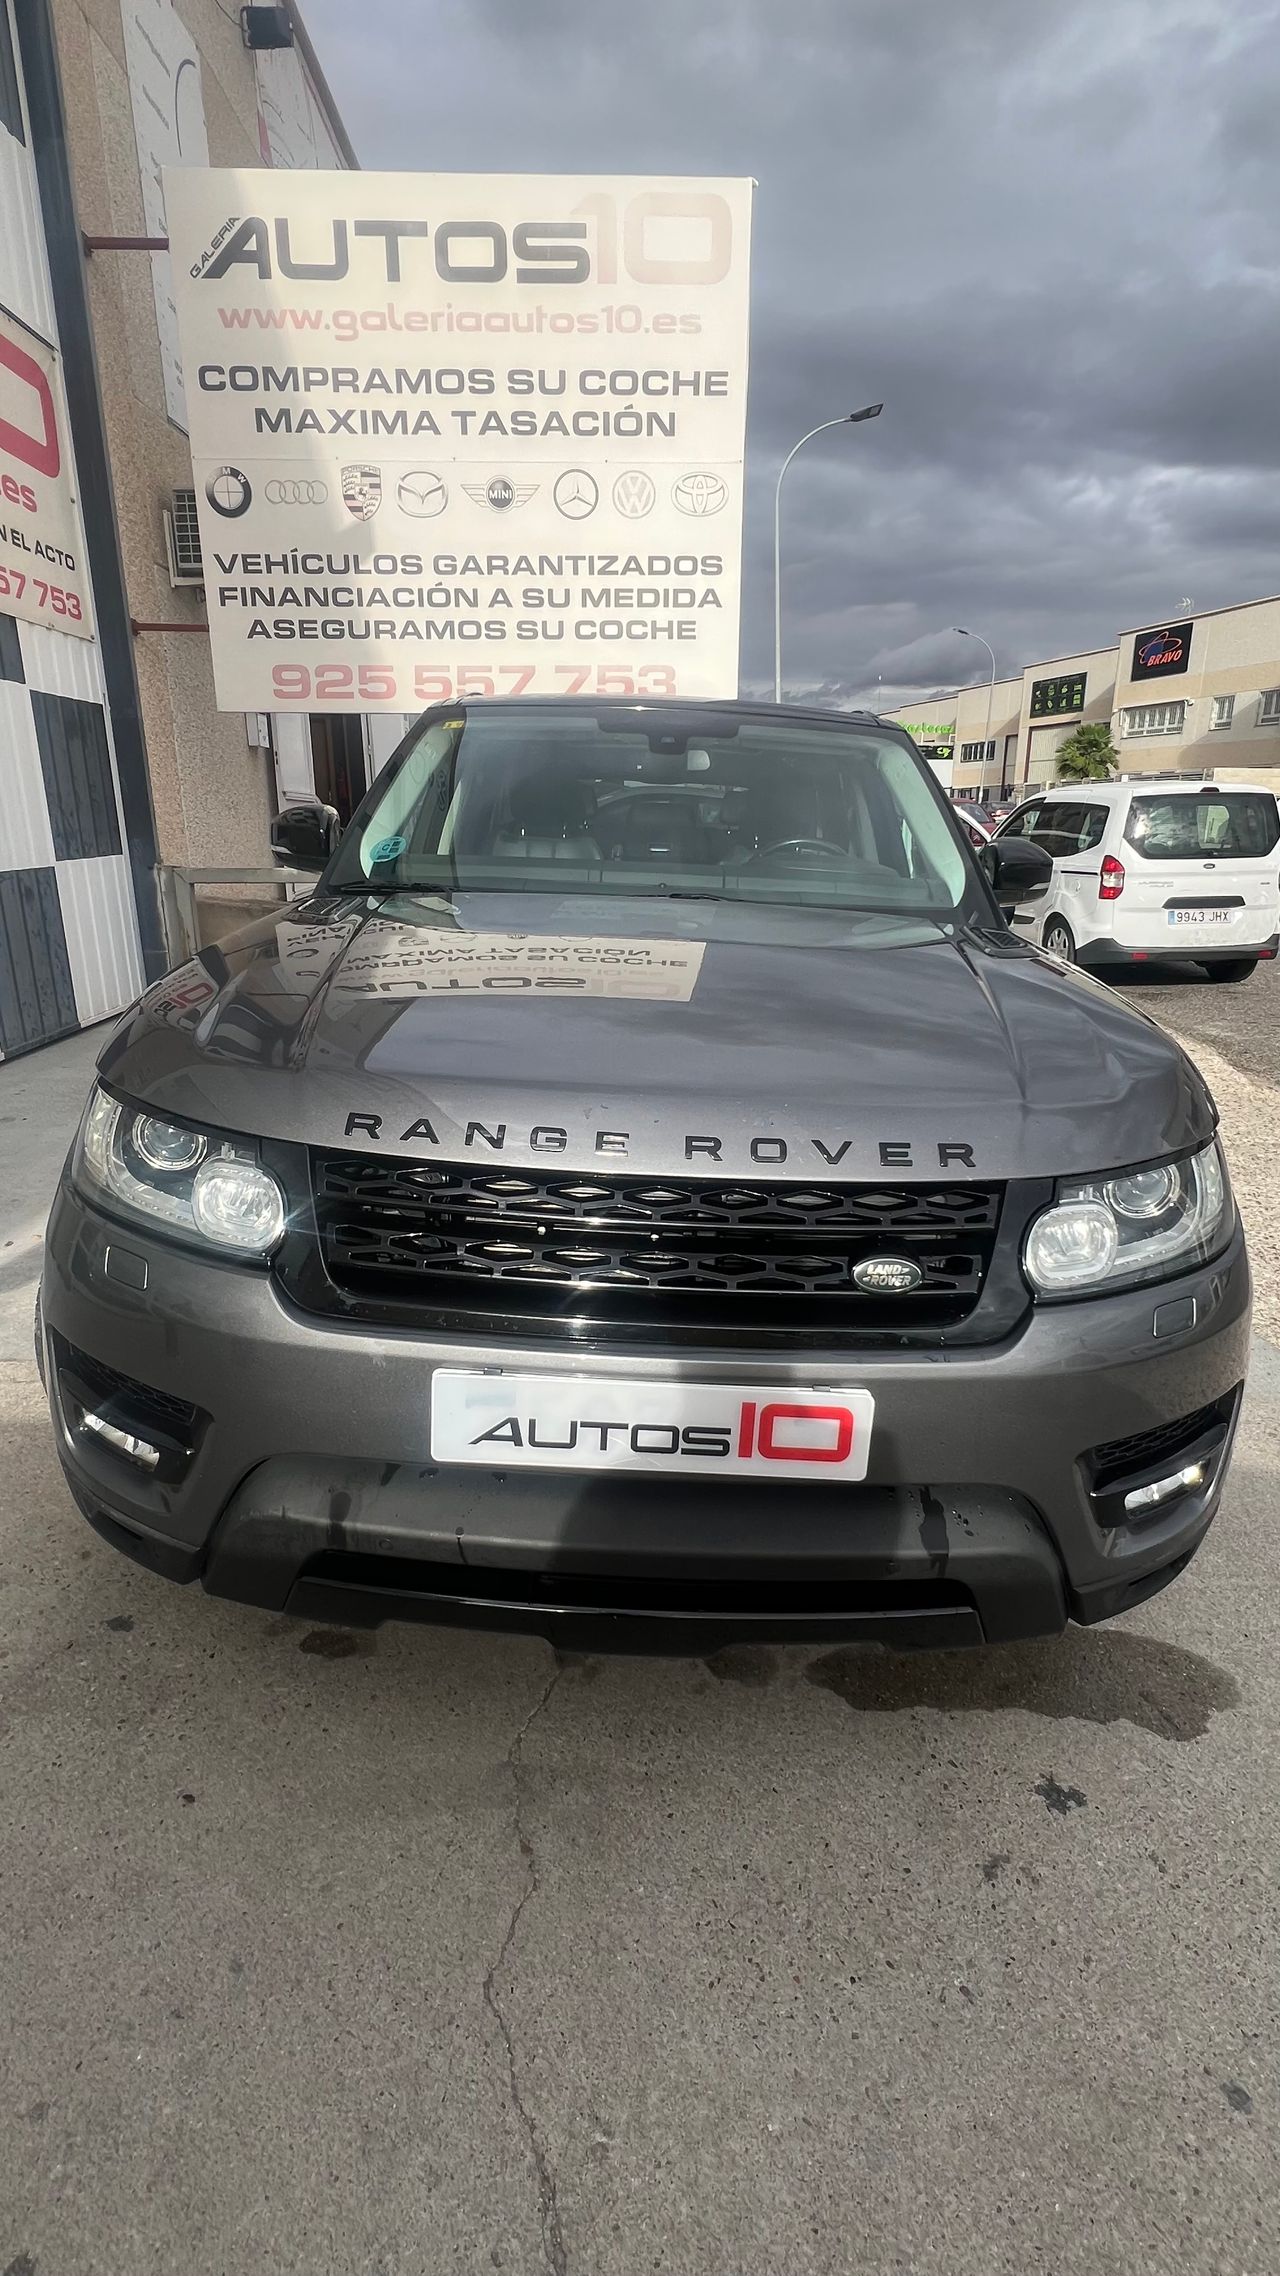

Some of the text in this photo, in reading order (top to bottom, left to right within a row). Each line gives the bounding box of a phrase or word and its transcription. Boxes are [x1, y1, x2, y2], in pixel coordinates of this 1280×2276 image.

[189, 217, 241, 279] GALERIA
[217, 302, 702, 342] www.galeriaautos10.es
[199, 366, 496, 396] COMPRAMOS
[507, 369, 567, 396] SU
[578, 370, 729, 397] COCHE
[255, 404, 676, 437] MAXIMA TASACIÓN
[488, 489, 513, 500] MINI
[10, 528, 31, 553] EL
[35, 540, 75, 571] ACTO
[213, 549, 723, 577] VEHÍCULOS GARANTIZADOS
[33, 579, 82, 620] 753
[219, 582, 723, 609] FINANCIACIÓN A SU MEDIDA
[247, 619, 697, 640] ASEGURAMOS SU COCHE
[1147, 650, 1183, 667] BRAVO
[272, 664, 677, 700] 925 557 753
[1176, 911, 1229, 922] 9943 JHX
[344, 1112, 977, 1168] RANGE ROVER
[867, 1264, 902, 1275] LAND
[870, 1274, 911, 1287] ROVER
